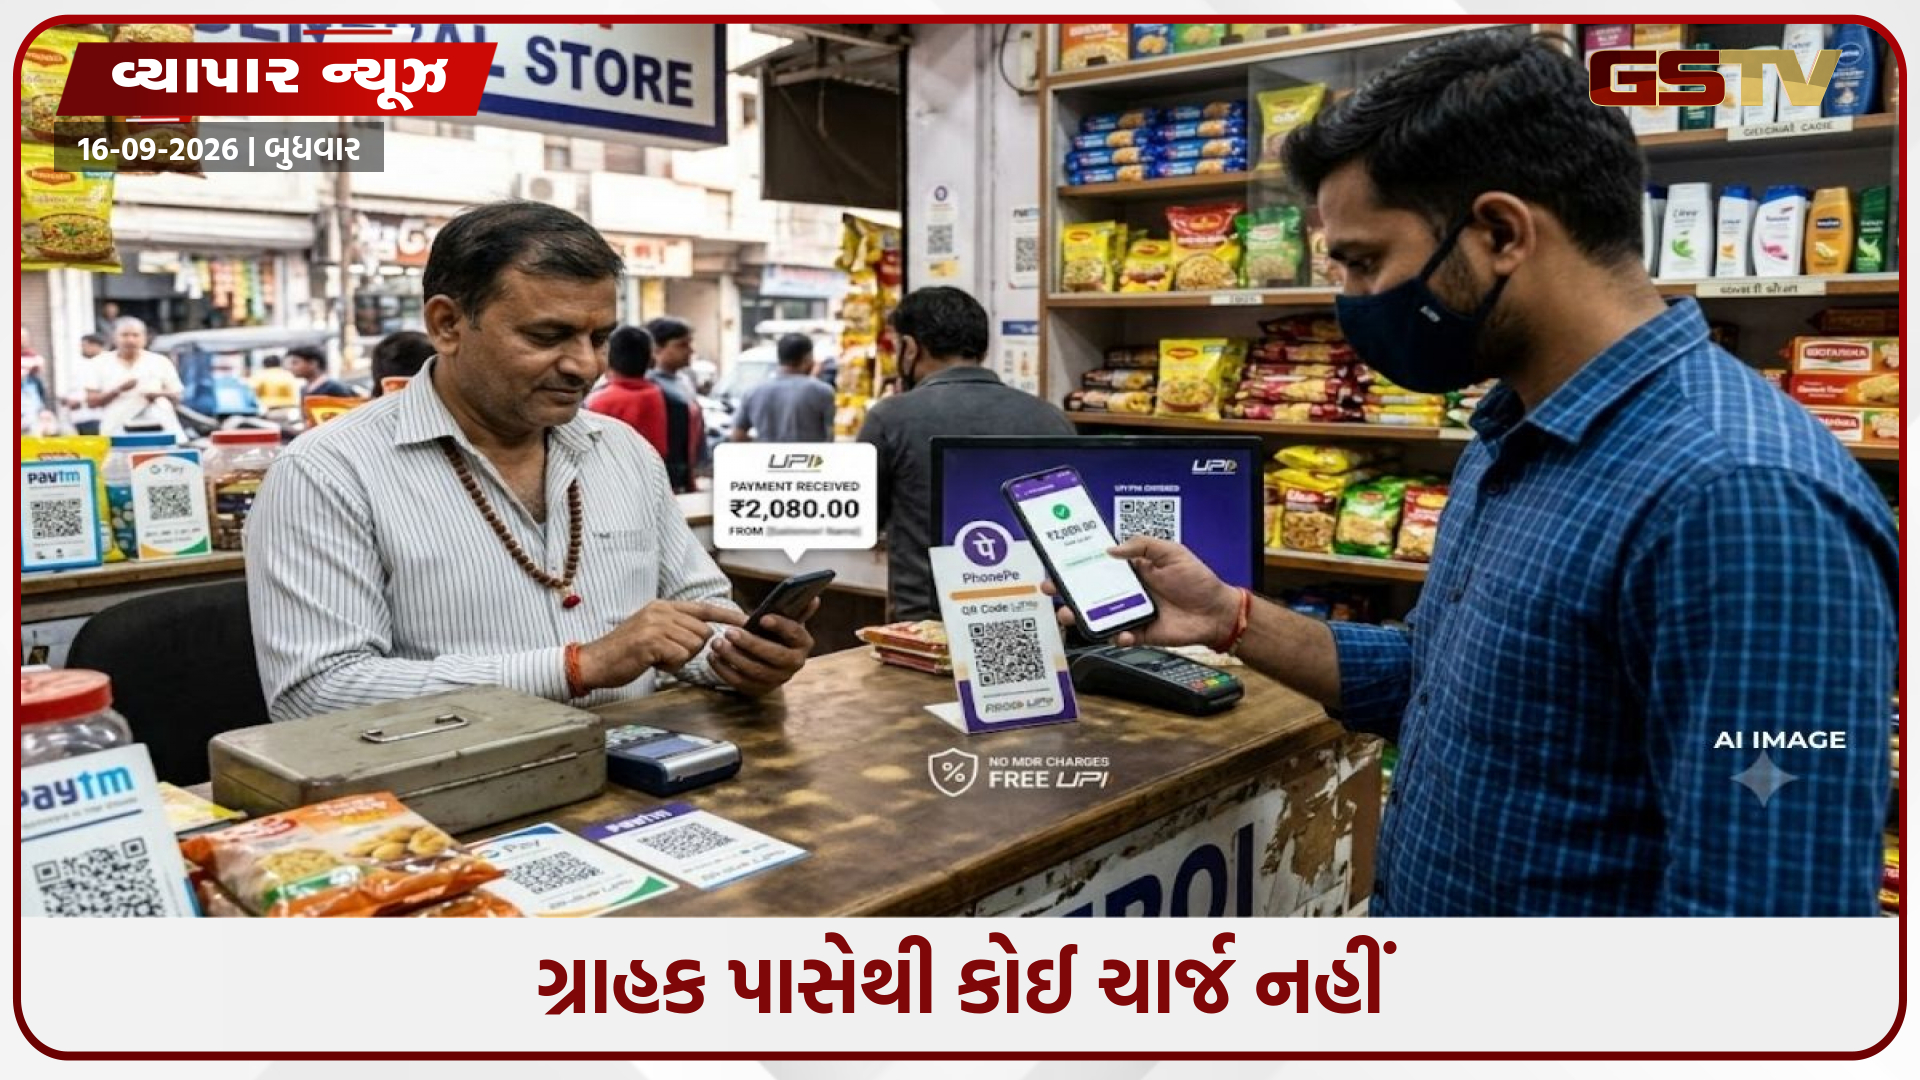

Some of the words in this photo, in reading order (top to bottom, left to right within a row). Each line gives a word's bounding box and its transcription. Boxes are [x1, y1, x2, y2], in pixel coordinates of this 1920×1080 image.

[525, 39, 693, 107] STORE
[1192, 459, 1238, 472] UPI
[962, 569, 1020, 584] PhonePe
[981, 603, 1009, 614] Code
